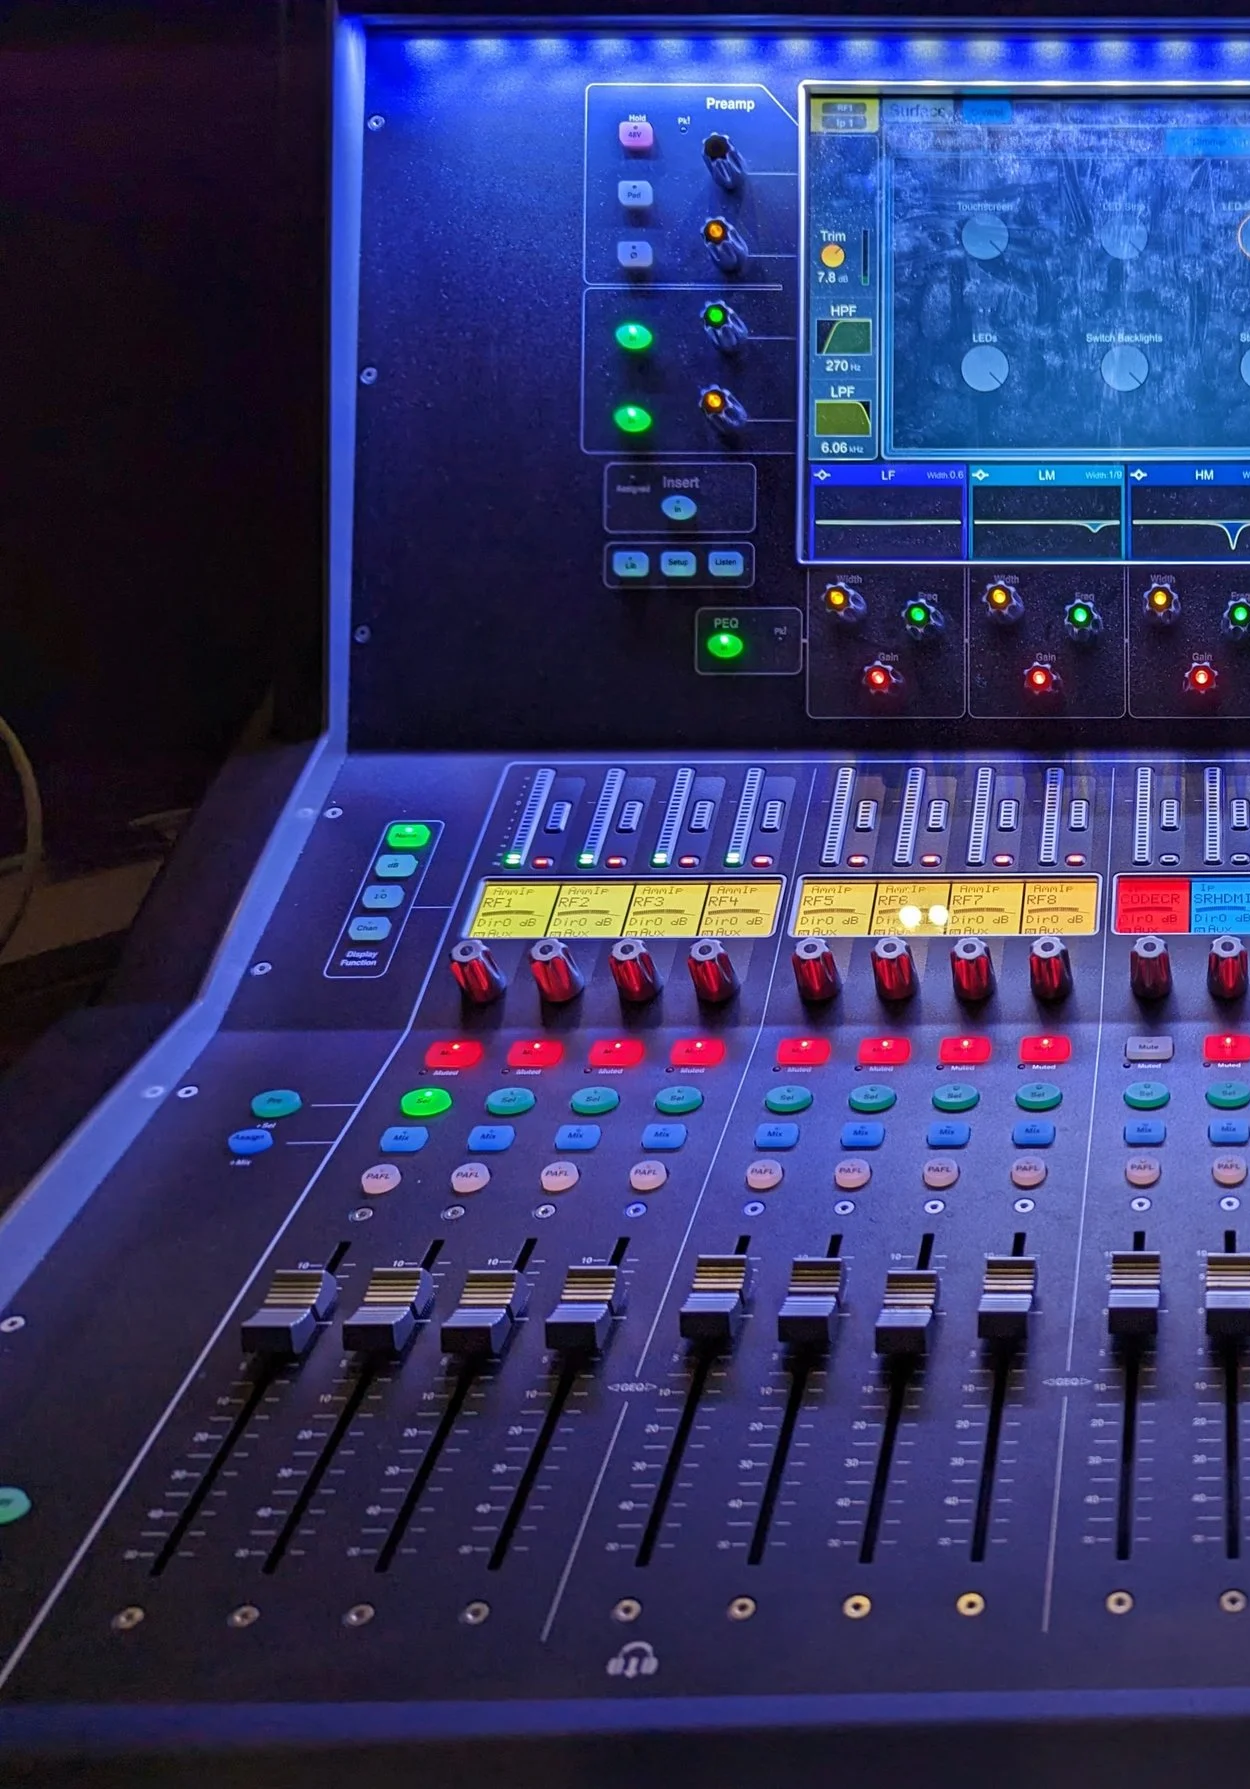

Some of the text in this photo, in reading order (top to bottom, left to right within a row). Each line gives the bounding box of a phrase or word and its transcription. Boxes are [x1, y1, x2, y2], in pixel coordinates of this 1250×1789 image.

[706, 98, 755, 111] Preamp
[837, 104, 852, 112] RF1
[629, 114, 646, 122] Hold
[820, 230, 847, 242] Trim
[818, 272, 836, 284] 7.8
[830, 305, 857, 316] HPF
[972, 334, 997, 342] LEDs
[825, 360, 848, 372] 270
[830, 386, 856, 398] LPF
[820, 442, 848, 454] 6.06
[881, 470, 896, 480] LF
[1038, 470, 1056, 480] LM
[1195, 470, 1214, 480] HM
[662, 476, 700, 489] Insert
[714, 618, 739, 629] PEQ
[483, 898, 512, 908] RF1
[558, 896, 590, 907] RF2
[633, 896, 665, 906] RF3
[708, 896, 738, 906] RF4
[803, 896, 834, 906] RF5
[952, 894, 983, 905] RF7
[1026, 894, 1057, 904] RF8
[1120, 894, 1180, 904] CODECR
[346, 950, 378, 959] Display
[340, 959, 377, 967] Function
